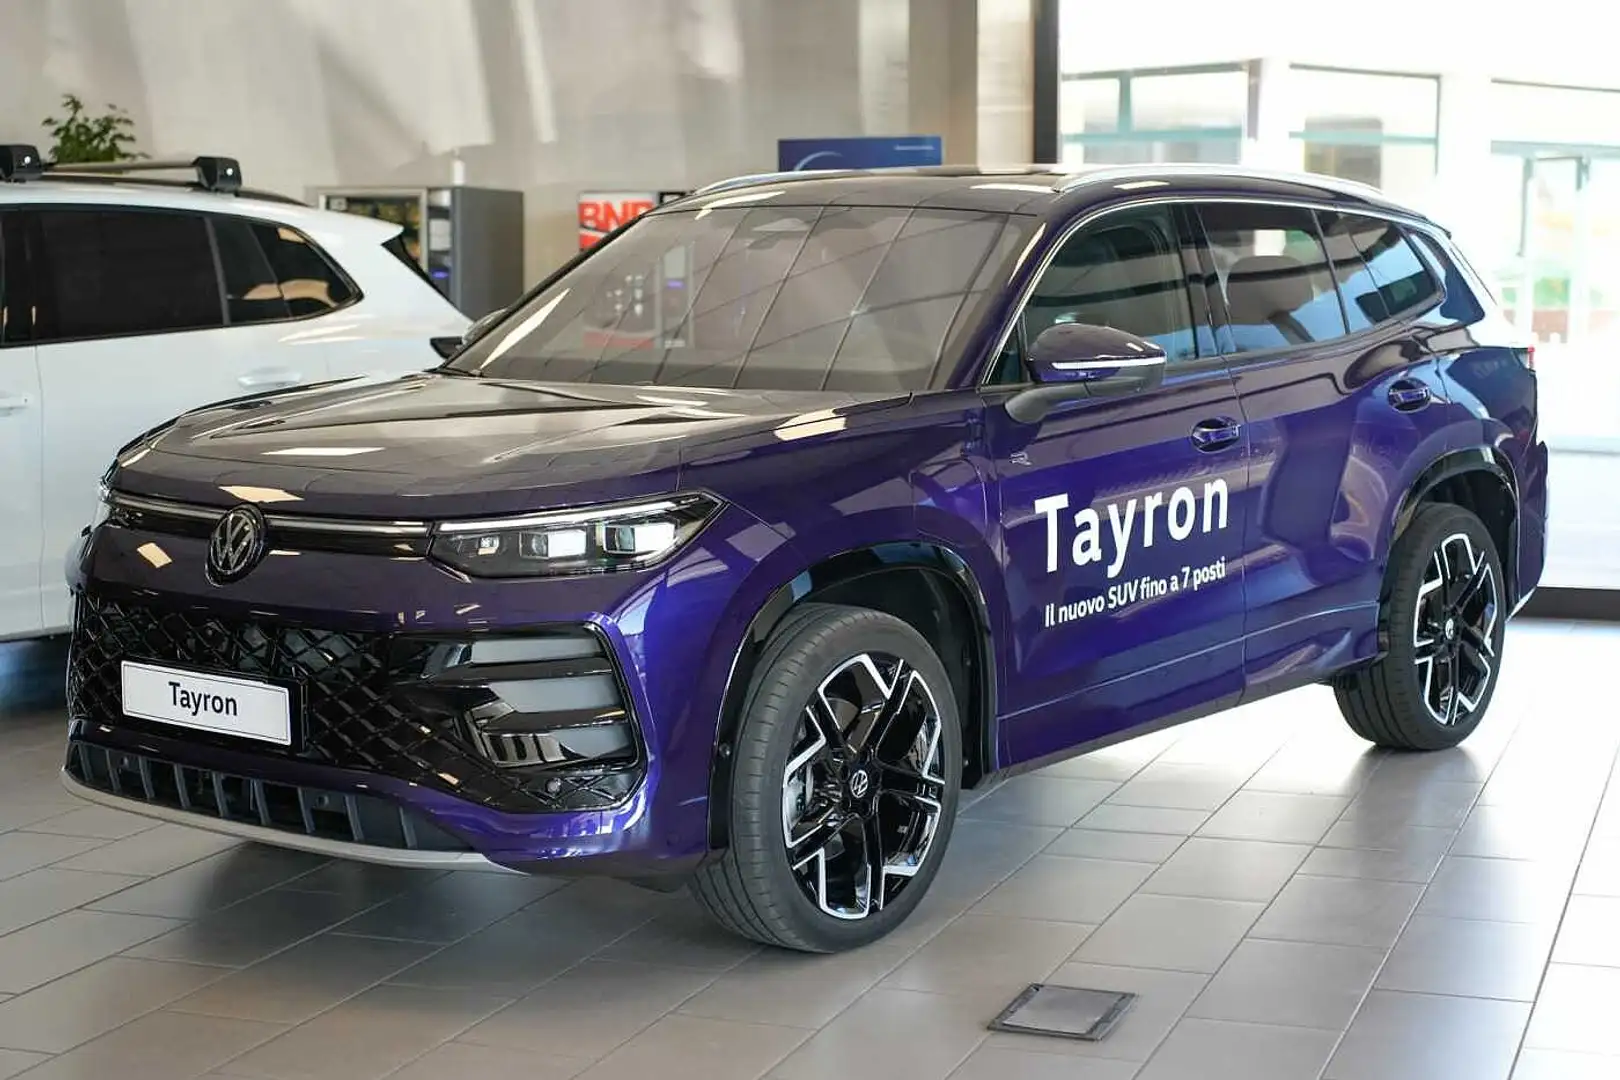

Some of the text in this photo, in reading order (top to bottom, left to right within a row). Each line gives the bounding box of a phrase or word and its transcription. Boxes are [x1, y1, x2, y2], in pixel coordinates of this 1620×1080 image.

[1034, 478, 1228, 578] Tayron
[1044, 556, 1226, 628] Il nuovo SUV fino a 7 posti
[168, 681, 238, 716] Tayron
